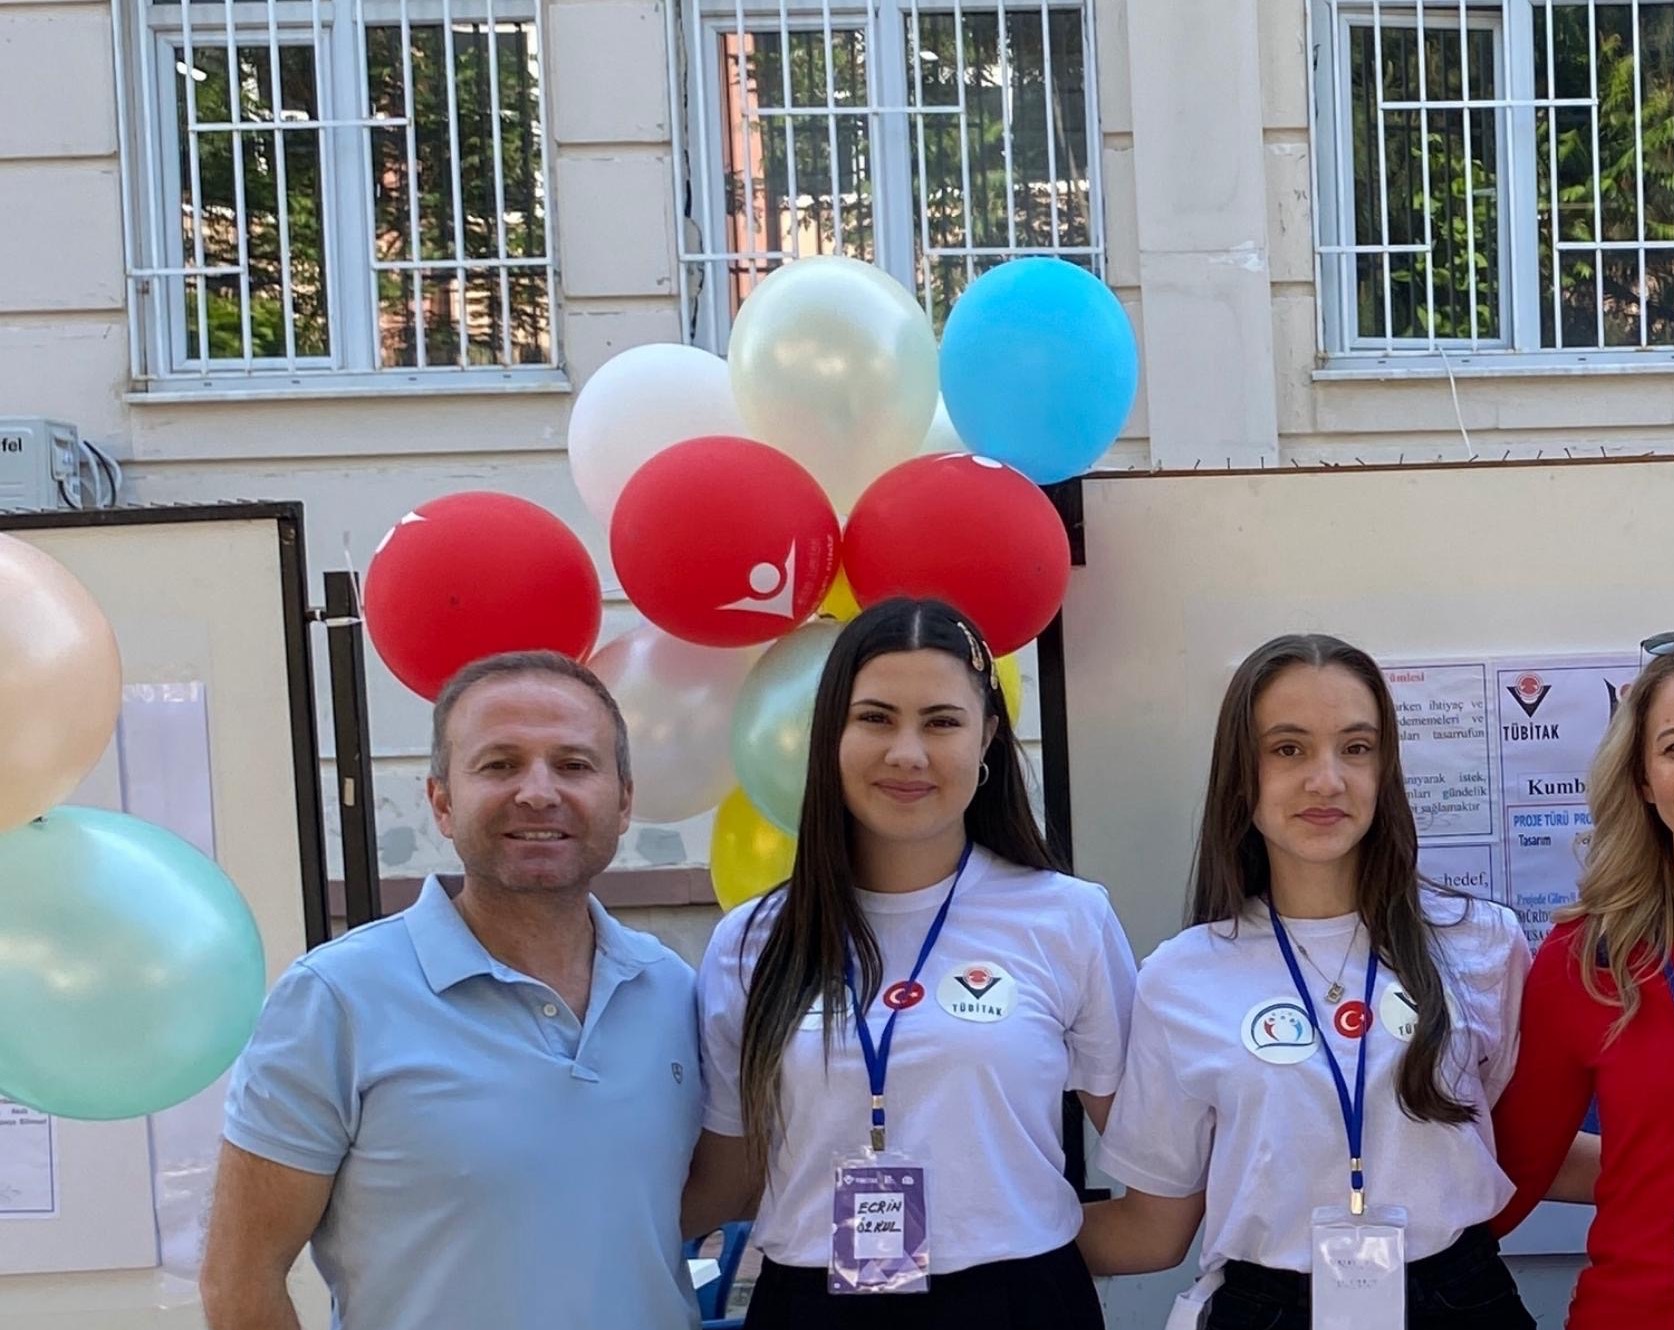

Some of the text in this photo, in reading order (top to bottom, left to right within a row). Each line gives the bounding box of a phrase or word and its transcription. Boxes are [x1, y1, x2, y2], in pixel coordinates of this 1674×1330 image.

[1, 436, 23, 453] fel
[1388, 671, 1425, 683] ümlesi
[1396, 714, 1460, 726] dememeleri
[1502, 721, 1560, 742] TÜBİTAK
[1528, 778, 1586, 796] Kumb
[1513, 813, 1543, 828] PROJE
[1545, 810, 1569, 827] TÜRÜ
[1517, 833, 1552, 847] Tasarım
[1443, 871, 1489, 888] hedef,
[952, 1002, 1002, 1017] TÜBİTAK
